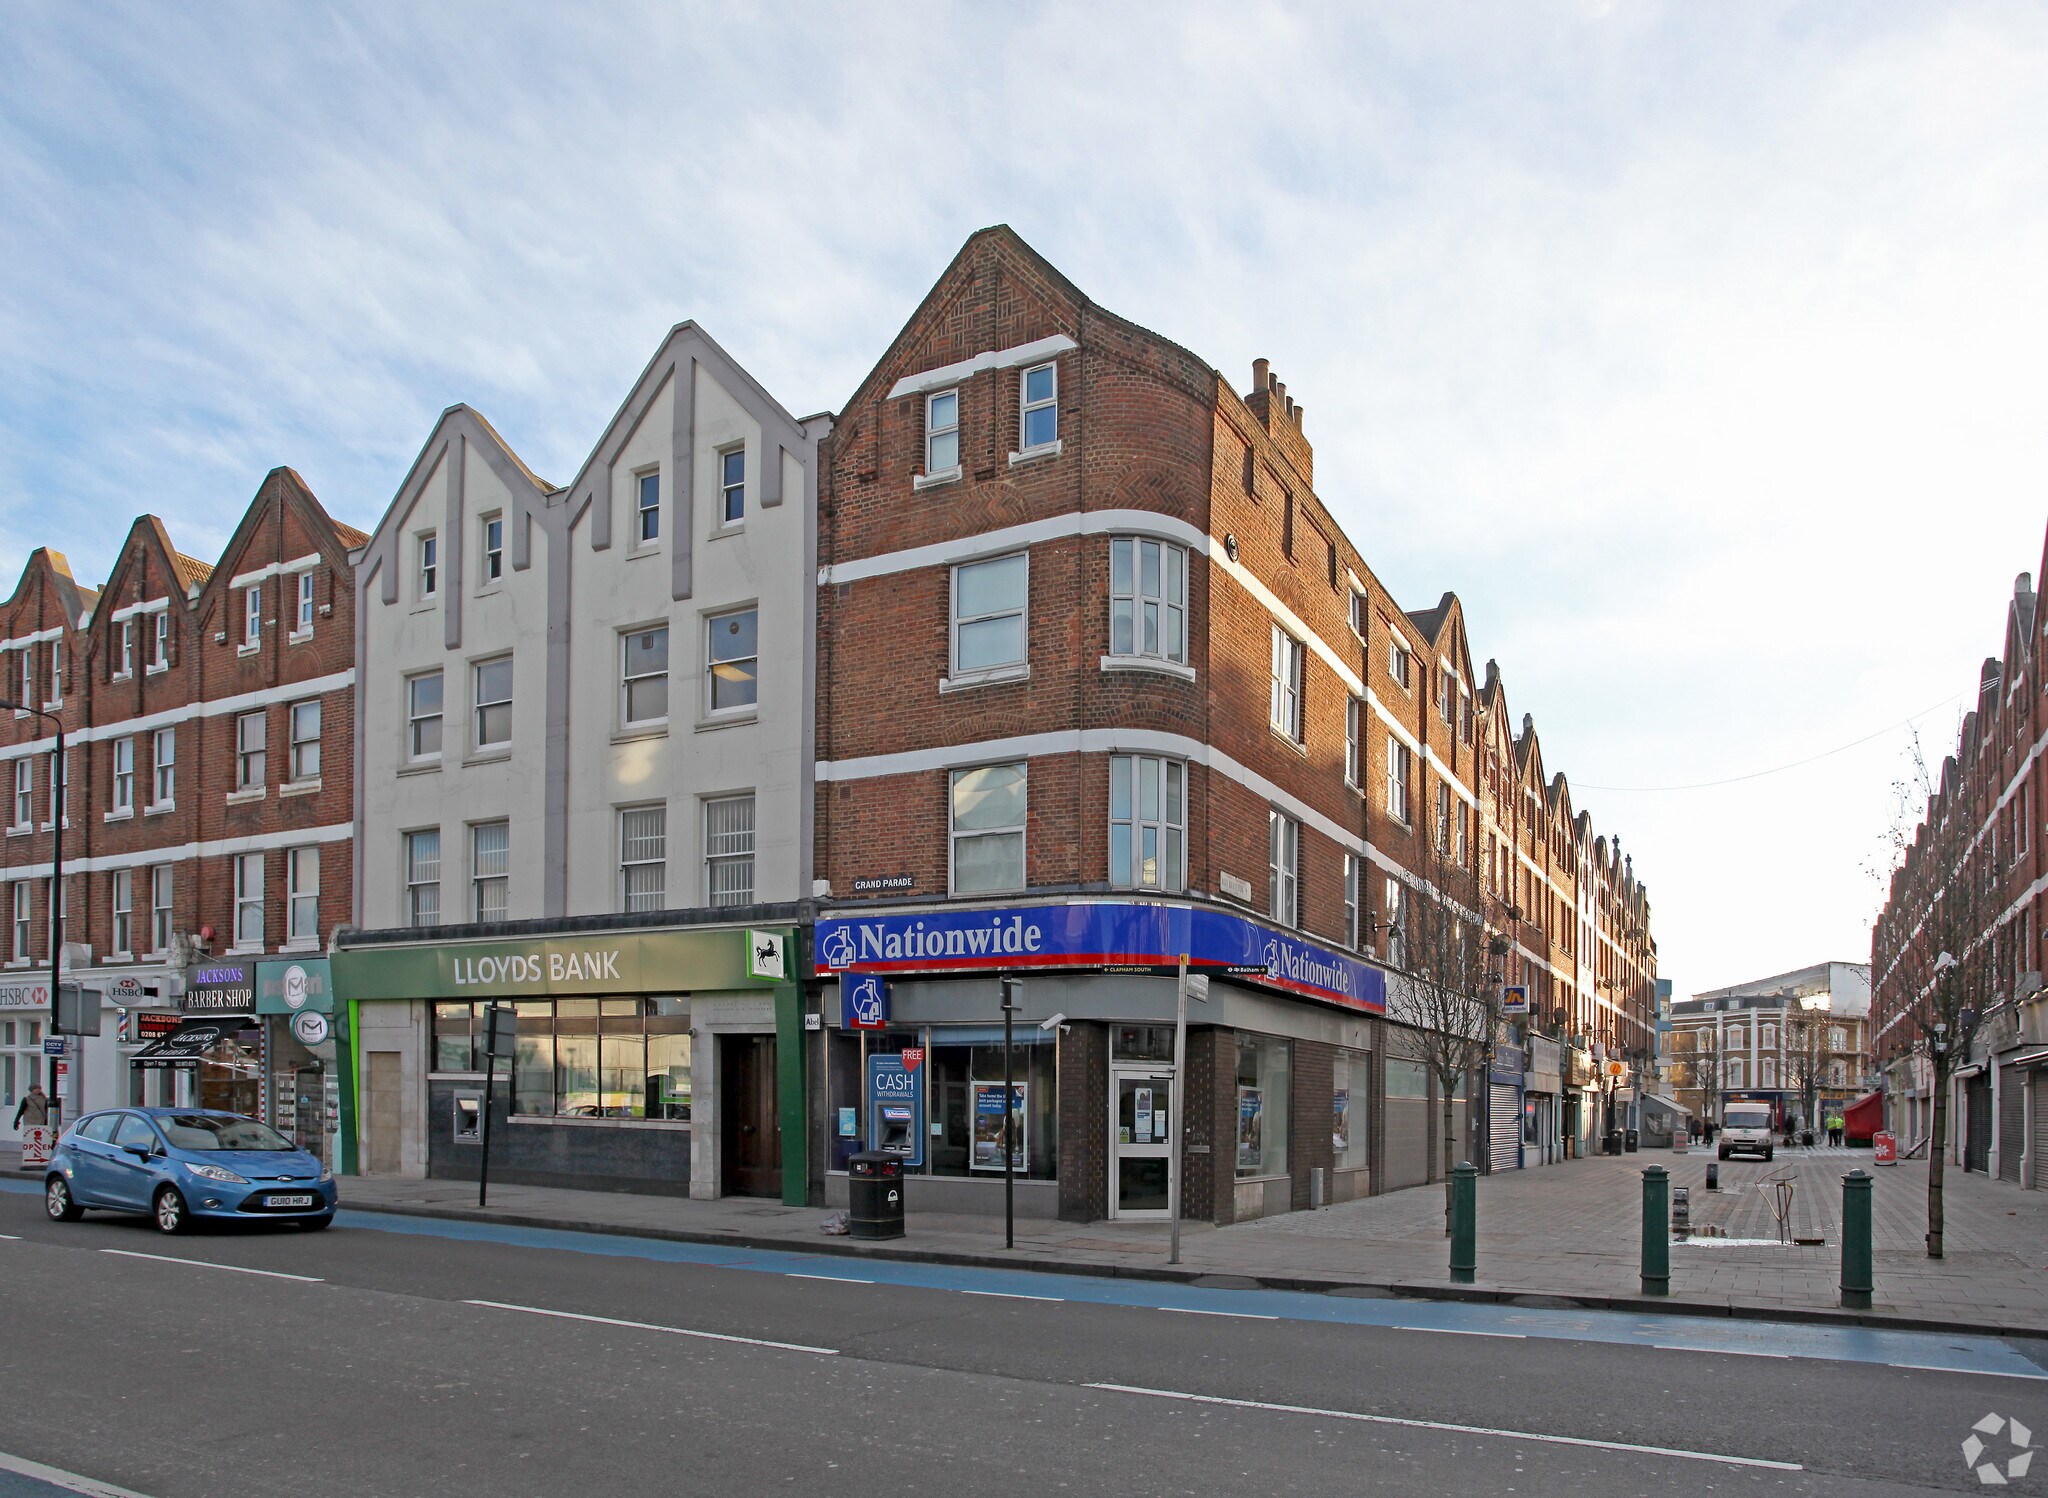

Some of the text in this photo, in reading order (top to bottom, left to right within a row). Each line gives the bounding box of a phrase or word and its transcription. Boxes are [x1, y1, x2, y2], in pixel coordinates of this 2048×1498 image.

[855, 878, 912, 890] GRAND PARADE
[859, 916, 1041, 960] Nationwide
[196, 968, 243, 983] JACKSONS
[454, 950, 621, 985] LLOYDS BANK
[1280, 942, 1349, 993] Nationwide
[0, 987, 30, 1006] HSBC
[112, 987, 143, 997] HSBC
[188, 990, 225, 1008] BARBER
[226, 988, 252, 1007] SHOP
[140, 1014, 182, 1024] JACKSONS
[902, 1050, 922, 1060] FREE
[876, 1073, 914, 1091] CASH
[271, 1197, 309, 1205] GU10 HRJ
